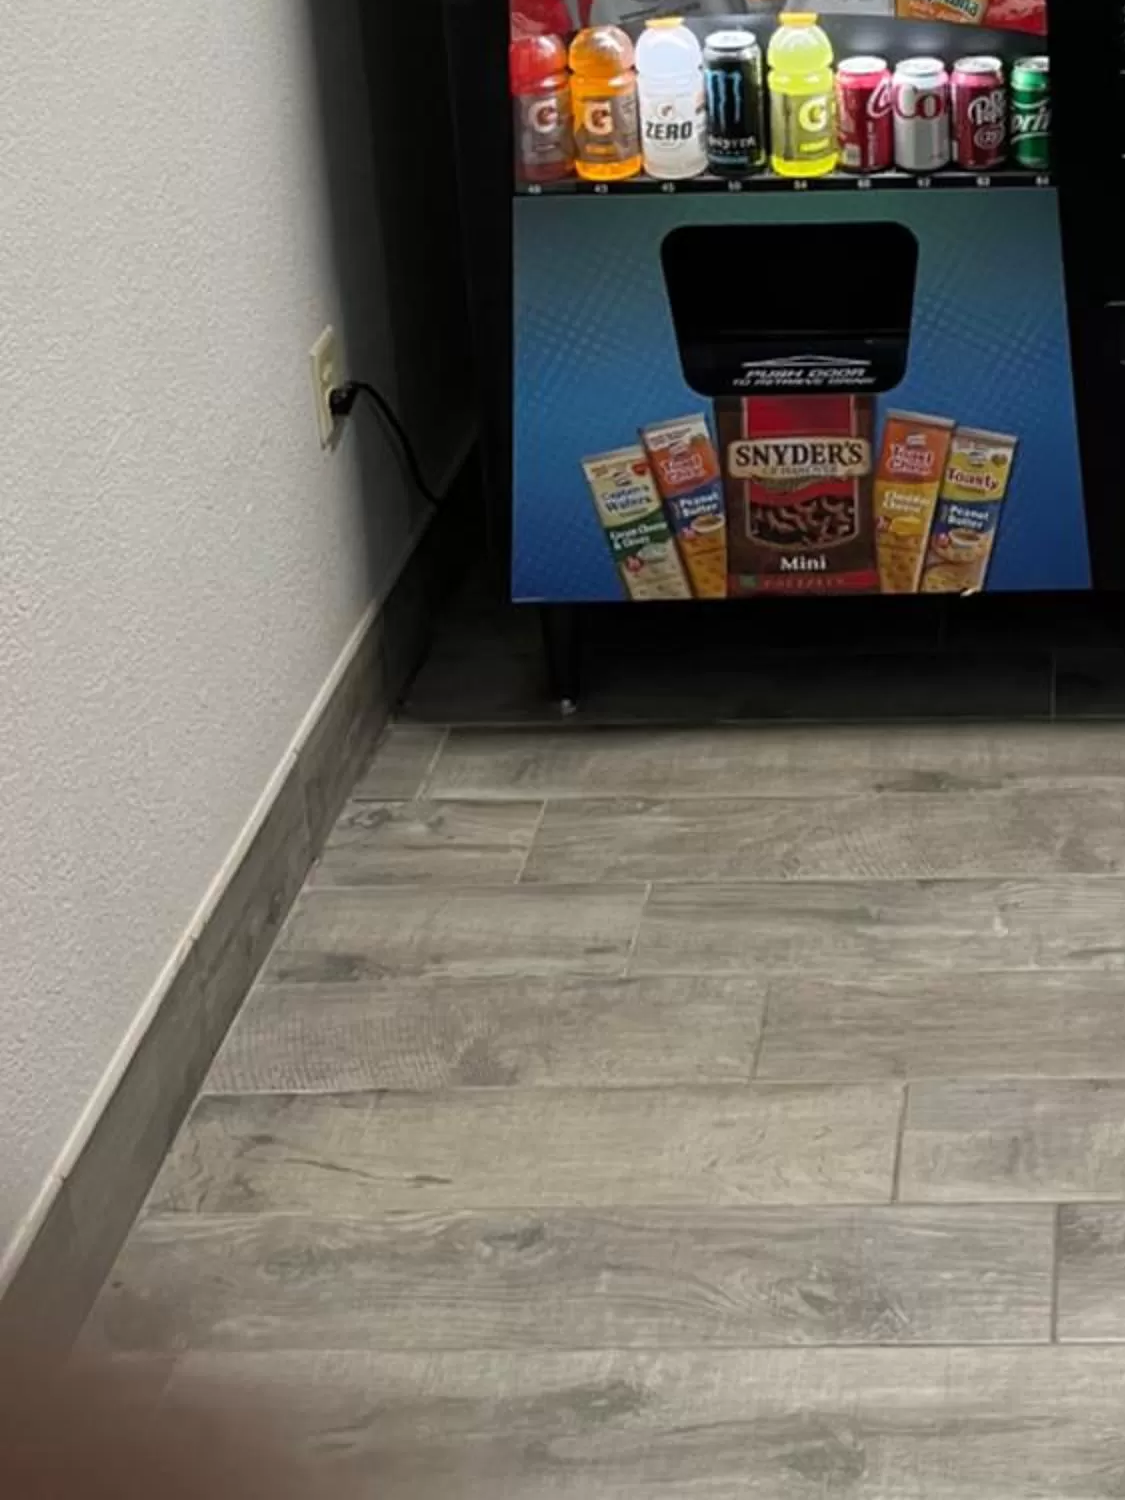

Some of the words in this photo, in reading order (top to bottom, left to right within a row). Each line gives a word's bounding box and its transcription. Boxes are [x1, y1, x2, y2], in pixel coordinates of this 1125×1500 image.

[528, 99, 558, 133] G
[584, 100, 614, 136] G
[799, 97, 827, 132] G
[645, 120, 693, 141] ZERO
[735, 442, 864, 467] SNYDER'S
[780, 553, 827, 572] Mini
